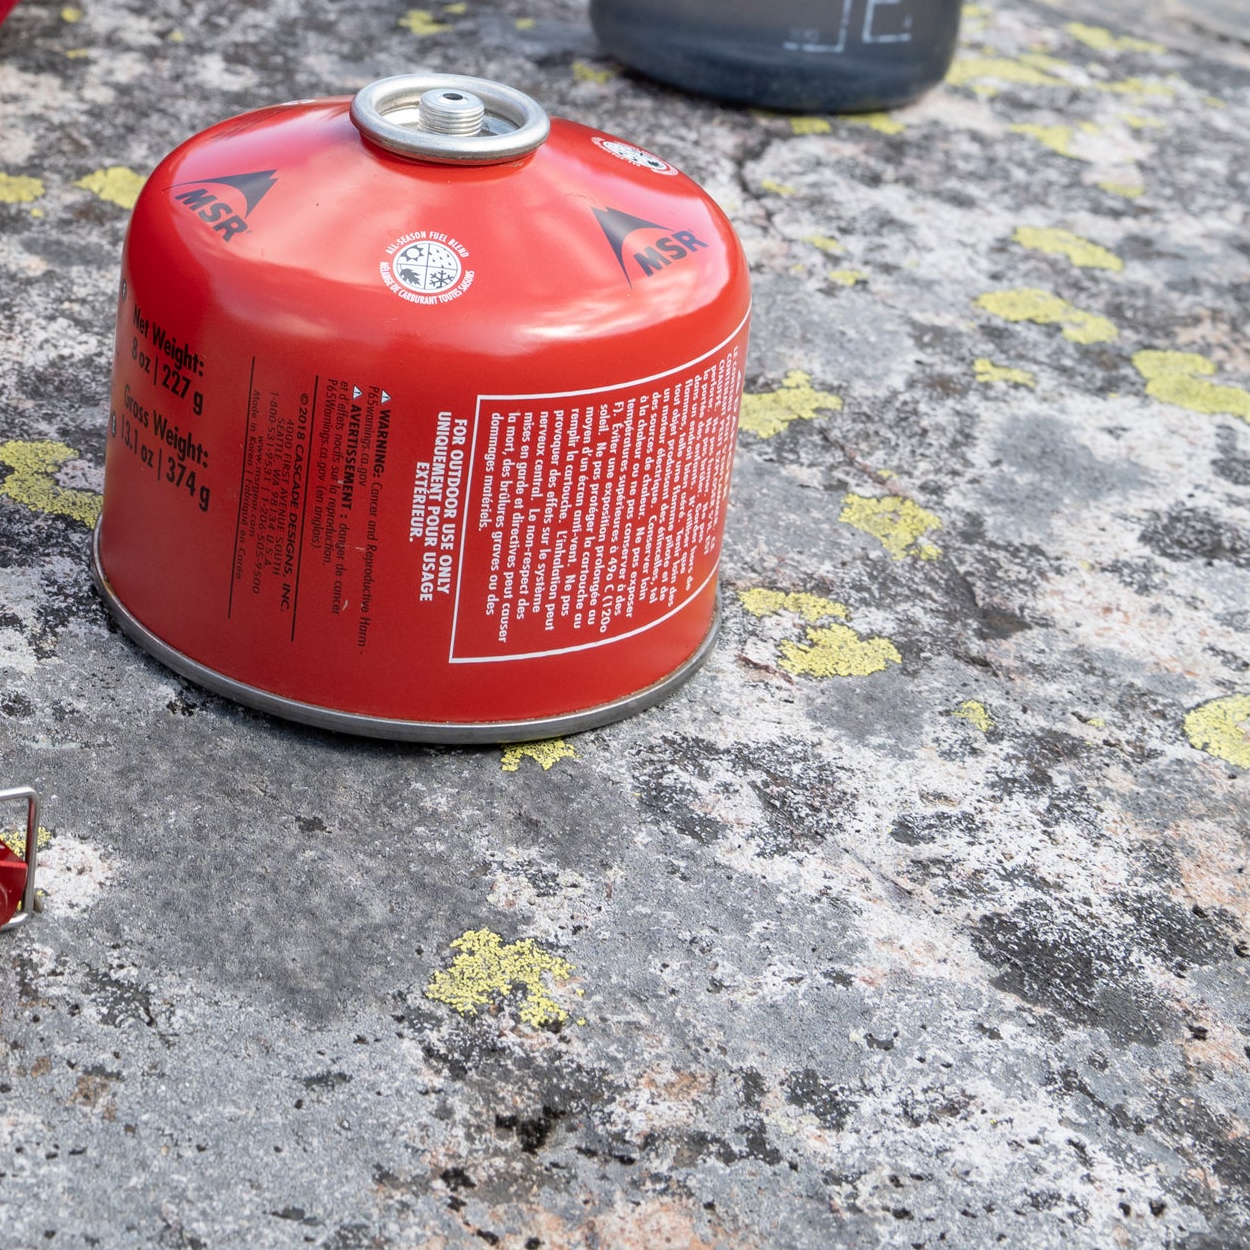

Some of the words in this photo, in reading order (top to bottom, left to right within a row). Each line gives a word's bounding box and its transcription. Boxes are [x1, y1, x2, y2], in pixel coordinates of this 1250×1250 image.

[175, 188, 248, 243] MSR
[385, 231, 427, 255] ALL-SEASON
[430, 231, 448, 242] FUEL
[447, 238, 469, 258] BLEND
[633, 230, 709, 277] MSR
[398, 290, 437, 305] CARBURANT
[133, 303, 149, 338] Net
[152, 322, 204, 377] Weight:
[132, 336, 138, 360] 8
[139, 352, 151, 374] oz
[162, 364, 192, 399] 227
[193, 391, 203, 416] g
[339, 380, 348, 391] et
[251, 389, 260, 418] Made
[612, 400, 624, 416] F).
[638, 404, 649, 416] la
[639, 395, 649, 403] à
[124, 383, 149, 428] Gross
[153, 410, 208, 468] Weight:
[249, 422, 256, 431] in
[451, 418, 467, 444] FOR
[507, 412, 520, 422] la
[521, 411, 534, 442] mises
[566, 408, 580, 447] remplir
[582, 406, 593, 443] moyen
[597, 403, 610, 435] soleil.
[284, 418, 294, 449] 4000
[332, 433, 343, 462] nocifs
[372, 409, 391, 478] WARNING:
[483, 412, 504, 472] dommages
[501, 425, 515, 455] mort,
[535, 411, 548, 455] nerveux
[549, 409, 564, 465] provoquer
[609, 422, 624, 453] Éviter
[620, 397, 636, 471] températures
[633, 418, 647, 458] chaleur
[121, 414, 138, 455] 13.1
[141, 444, 154, 468] oz
[166, 456, 196, 497] 374
[199, 485, 210, 512] g
[247, 436, 256, 466] Korea
[340, 403, 361, 510] AVERTISSEMENT
[426, 411, 451, 501] UNIQUEMENT
[519, 444, 529, 458] en
[566, 450, 578, 461] la
[595, 441, 606, 457] Ne
[271, 469, 280, 485] WA
[281, 452, 291, 483] FIRST
[289, 443, 304, 509] CASCADE
[330, 465, 339, 481] sur
[501, 458, 515, 477] des
[515, 461, 528, 494] garde
[530, 459, 543, 500] central.
[547, 468, 561, 488] des
[592, 460, 601, 480] pas
[606, 457, 615, 478] une
[631, 462, 639, 477] ou
[315, 485, 327, 502] (en
[328, 484, 340, 494] la
[368, 481, 382, 516] Cancer
[443, 449, 463, 518] OUTDOOR
[558, 464, 573, 523] cartouche.
[575, 474, 588, 506] écran
[629, 480, 637, 495] ne
[267, 491, 278, 530] 98134
[276, 486, 288, 529] AVENUE
[409, 461, 431, 542] EXTÉRIEUR.
[478, 475, 493, 531] matériels.
[495, 480, 513, 527] brûlures
[513, 497, 523, 508] et
[528, 508, 540, 521] Le
[543, 490, 558, 523] effets
[584, 483, 599, 532] protéger
[598, 481, 612, 542] exposition
[610, 474, 626, 542] supérieures
[626, 498, 634, 519] pas
[239, 529, 245, 543] en
[322, 497, 336, 565] reproduction.
[334, 522, 350, 560] danger
[366, 519, 378, 540] and
[423, 505, 440, 546] POUR
[440, 523, 455, 549] USE
[506, 512, 524, 568] directives
[540, 526, 550, 545] sur
[566, 509, 581, 566] anti-vent.
[271, 536, 283, 575] SOUTH
[282, 512, 297, 577] DESIGNS,
[490, 530, 502, 571] graves
[538, 548, 551, 559] le
[583, 535, 595, 548] la
[609, 545, 618, 553] à
[618, 522, 631, 579] conserver
[335, 563, 347, 576] de
[436, 554, 452, 594] ONLY
[518, 525, 535, 594] non-respect
[360, 543, 377, 613] Reproductive
[419, 551, 436, 601] USAGE
[488, 574, 497, 590] ou
[502, 571, 513, 598] peut
[532, 562, 545, 612] système
[563, 574, 575, 591] Ne
[575, 551, 589, 609] cartouche
[589, 545, 605, 606] prolongée
[604, 584, 614, 592] C
[616, 583, 626, 591] à
[279, 582, 291, 611] INC.
[331, 579, 342, 615] cancer
[485, 593, 499, 615] des
[516, 598, 529, 619] des
[560, 594, 570, 616] pas
[613, 594, 625, 615] des
[357, 616, 371, 647] Harm
[498, 602, 510, 642] causer
[544, 603, 555, 630] peut
[573, 612, 582, 628] au
[587, 609, 595, 625] au
